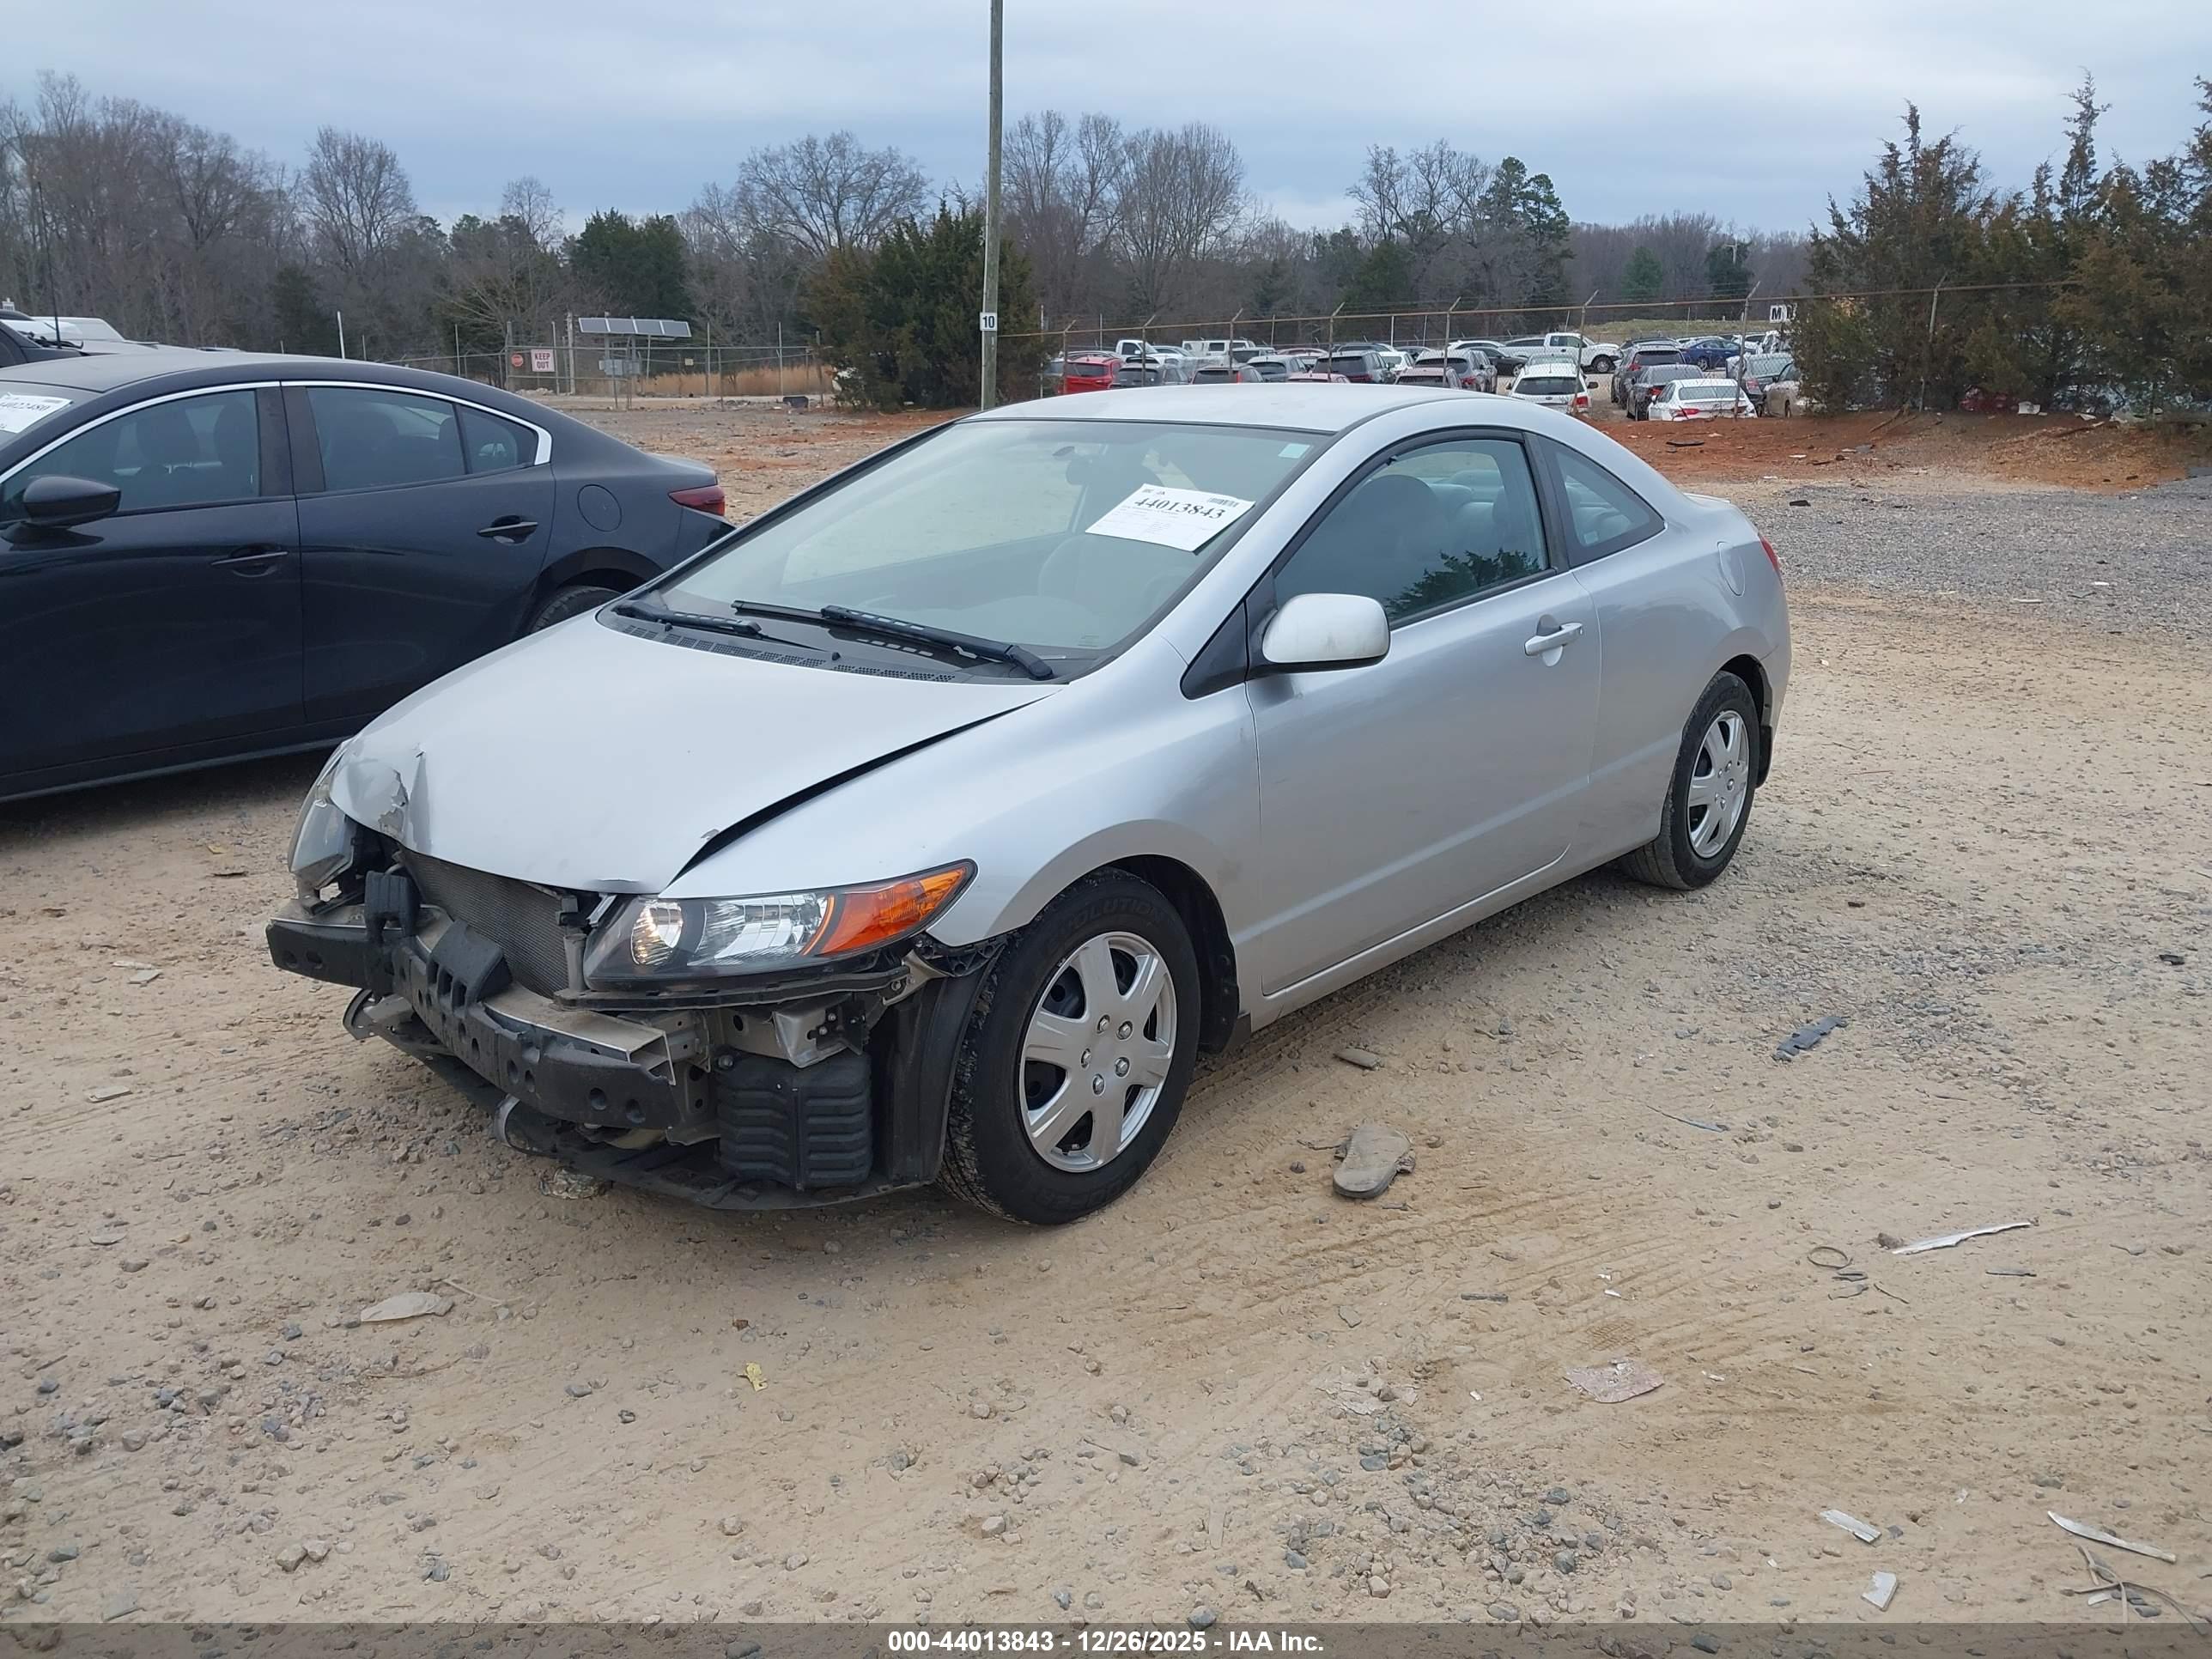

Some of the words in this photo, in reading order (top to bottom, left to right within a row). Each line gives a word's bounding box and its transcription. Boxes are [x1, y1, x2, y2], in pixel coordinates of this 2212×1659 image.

[982, 315, 995, 328] 10
[534, 352, 550, 361] KEEP
[537, 361, 550, 369] OUT
[1134, 497, 1225, 520] 44013843
